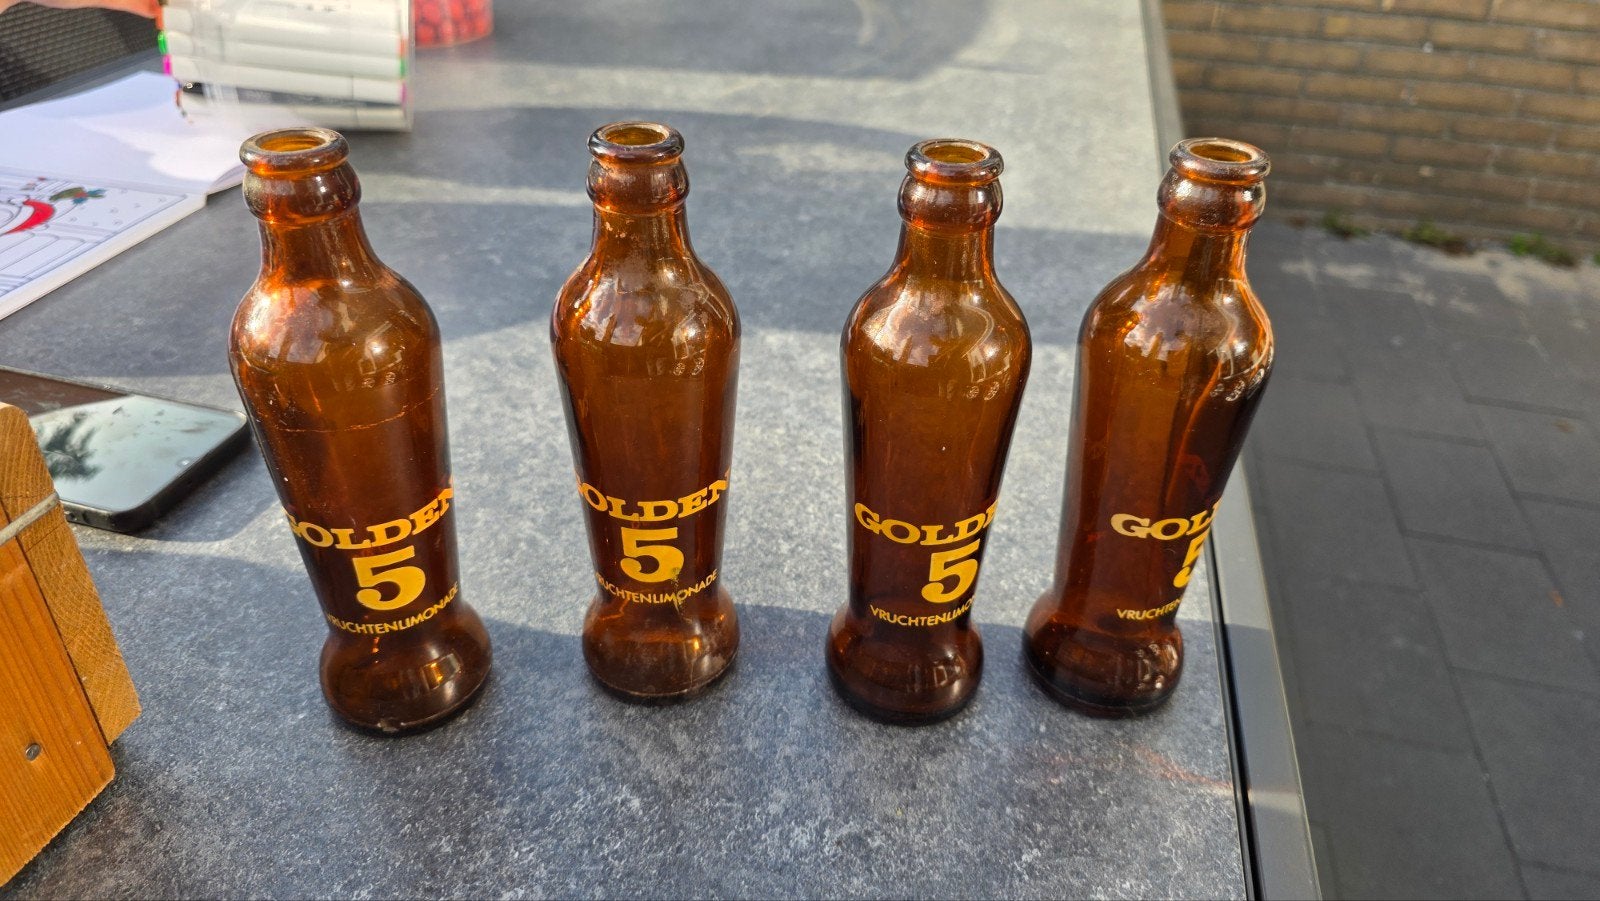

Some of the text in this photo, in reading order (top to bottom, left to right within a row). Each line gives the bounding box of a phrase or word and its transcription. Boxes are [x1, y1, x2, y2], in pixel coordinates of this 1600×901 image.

[1111, 498, 1221, 540] GOL
[353, 545, 426, 611] 5
[620, 526, 685, 583] 5
[921, 538, 980, 604] 5
